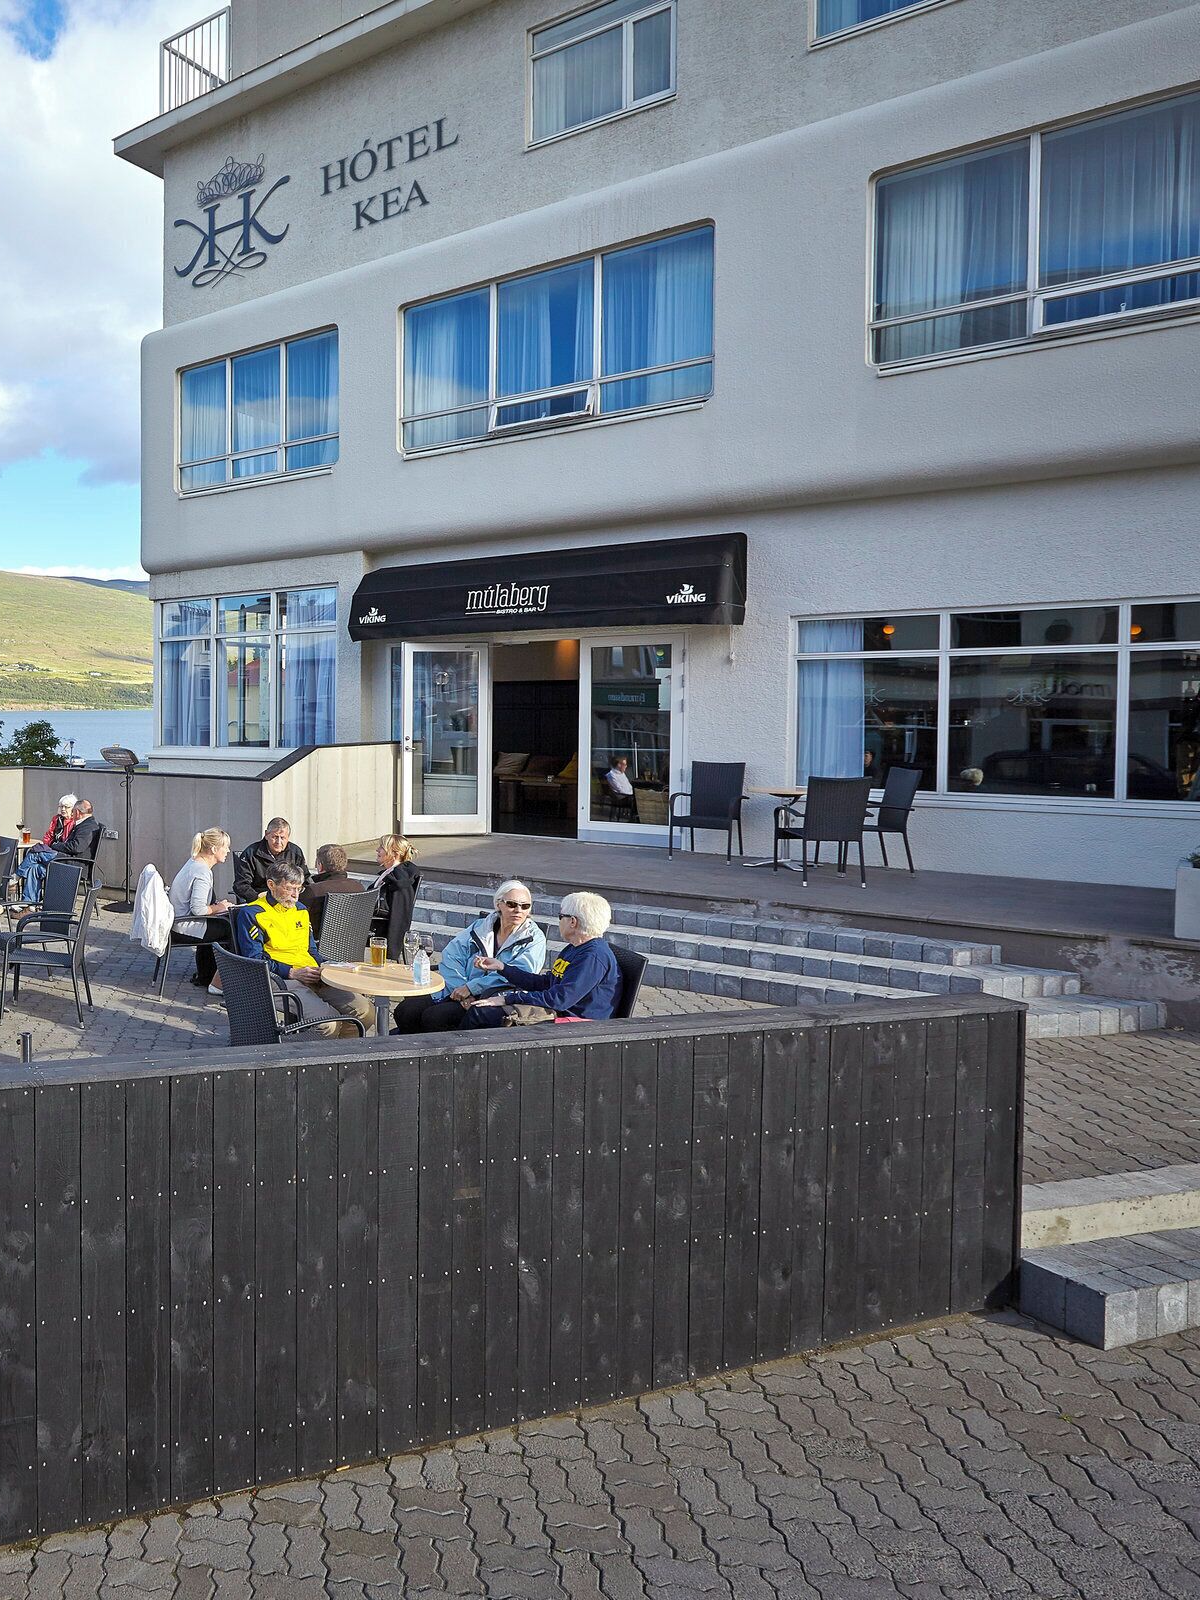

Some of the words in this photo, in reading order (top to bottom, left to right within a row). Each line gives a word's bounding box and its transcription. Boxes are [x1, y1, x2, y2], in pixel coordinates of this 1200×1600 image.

[320, 117, 459, 196] HÓTEL
[352, 180, 430, 231] KEA
[466, 583, 550, 612] múlaberg
[666, 593, 706, 604] VÍKING
[359, 615, 386, 624] VÍKING
